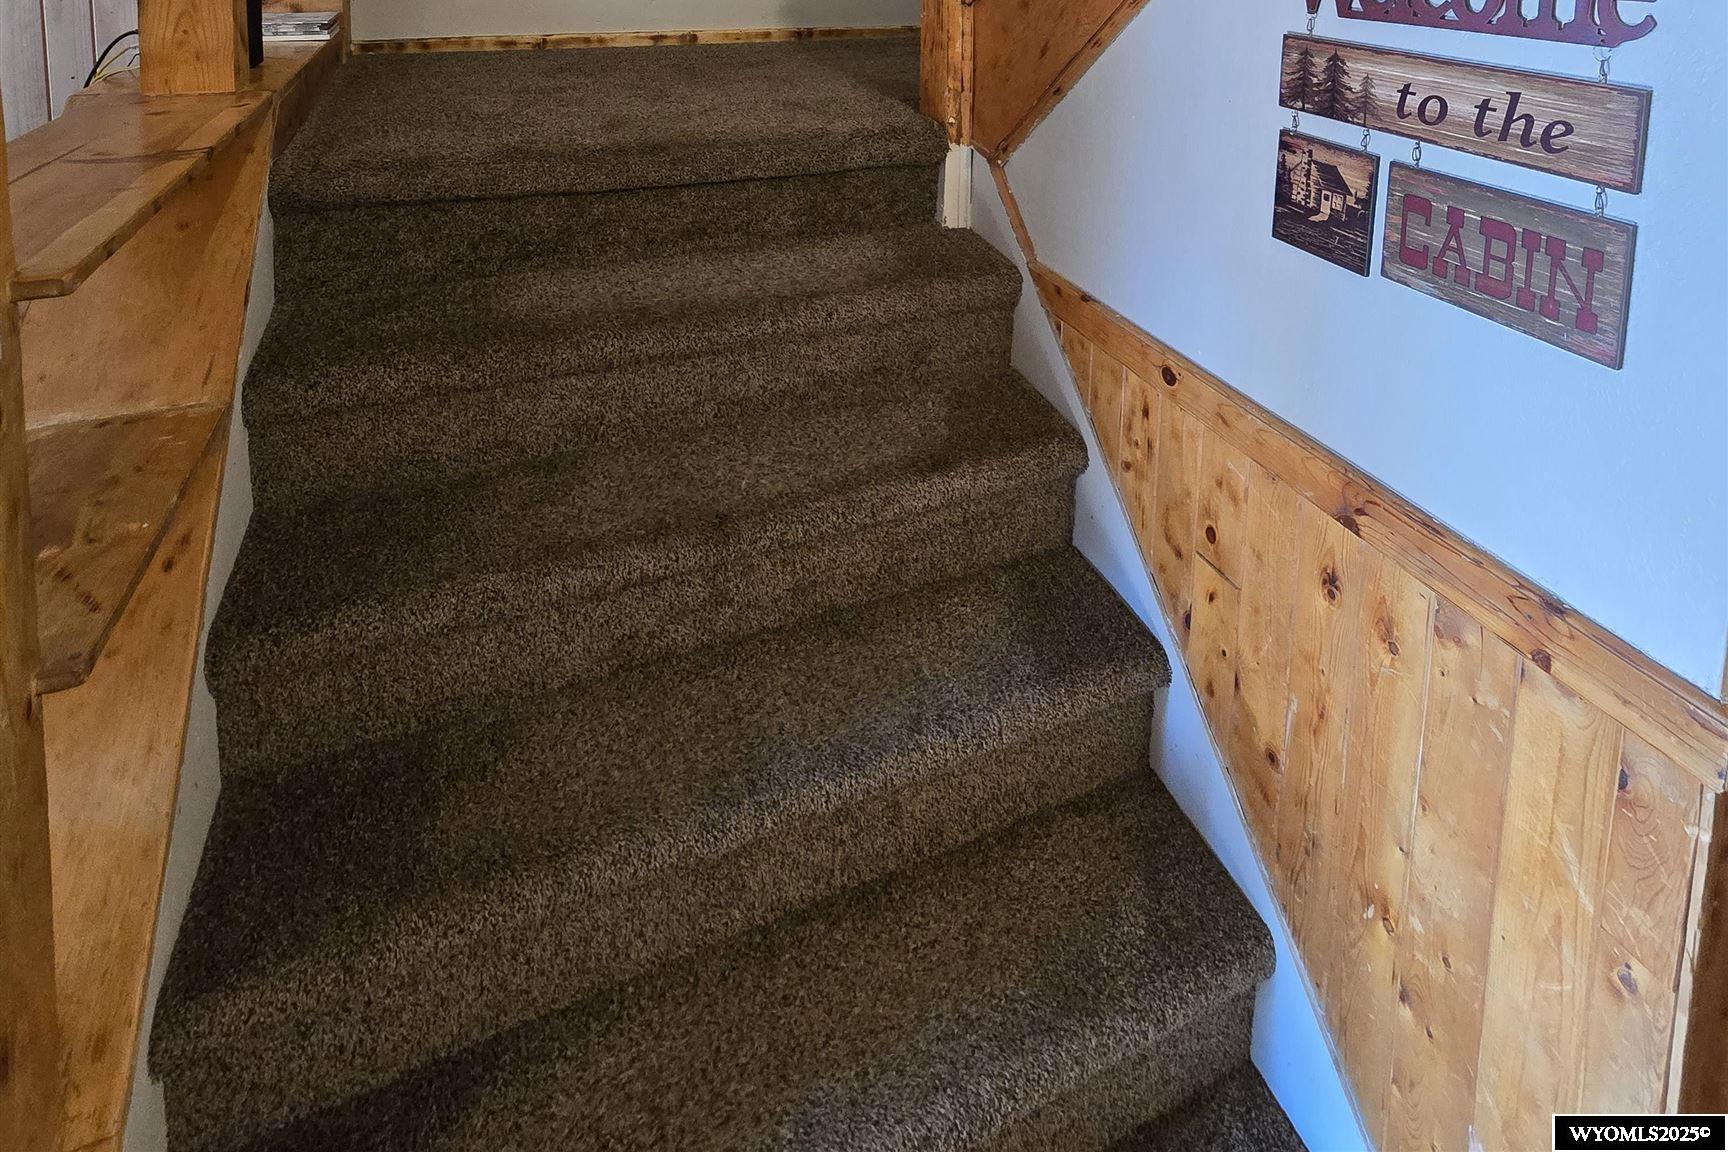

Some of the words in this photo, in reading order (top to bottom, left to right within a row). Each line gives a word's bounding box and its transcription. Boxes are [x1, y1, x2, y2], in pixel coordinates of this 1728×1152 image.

[1396, 82, 1449, 125] to
[1474, 91, 1575, 154] the
[1400, 193, 1604, 334] CABIN
